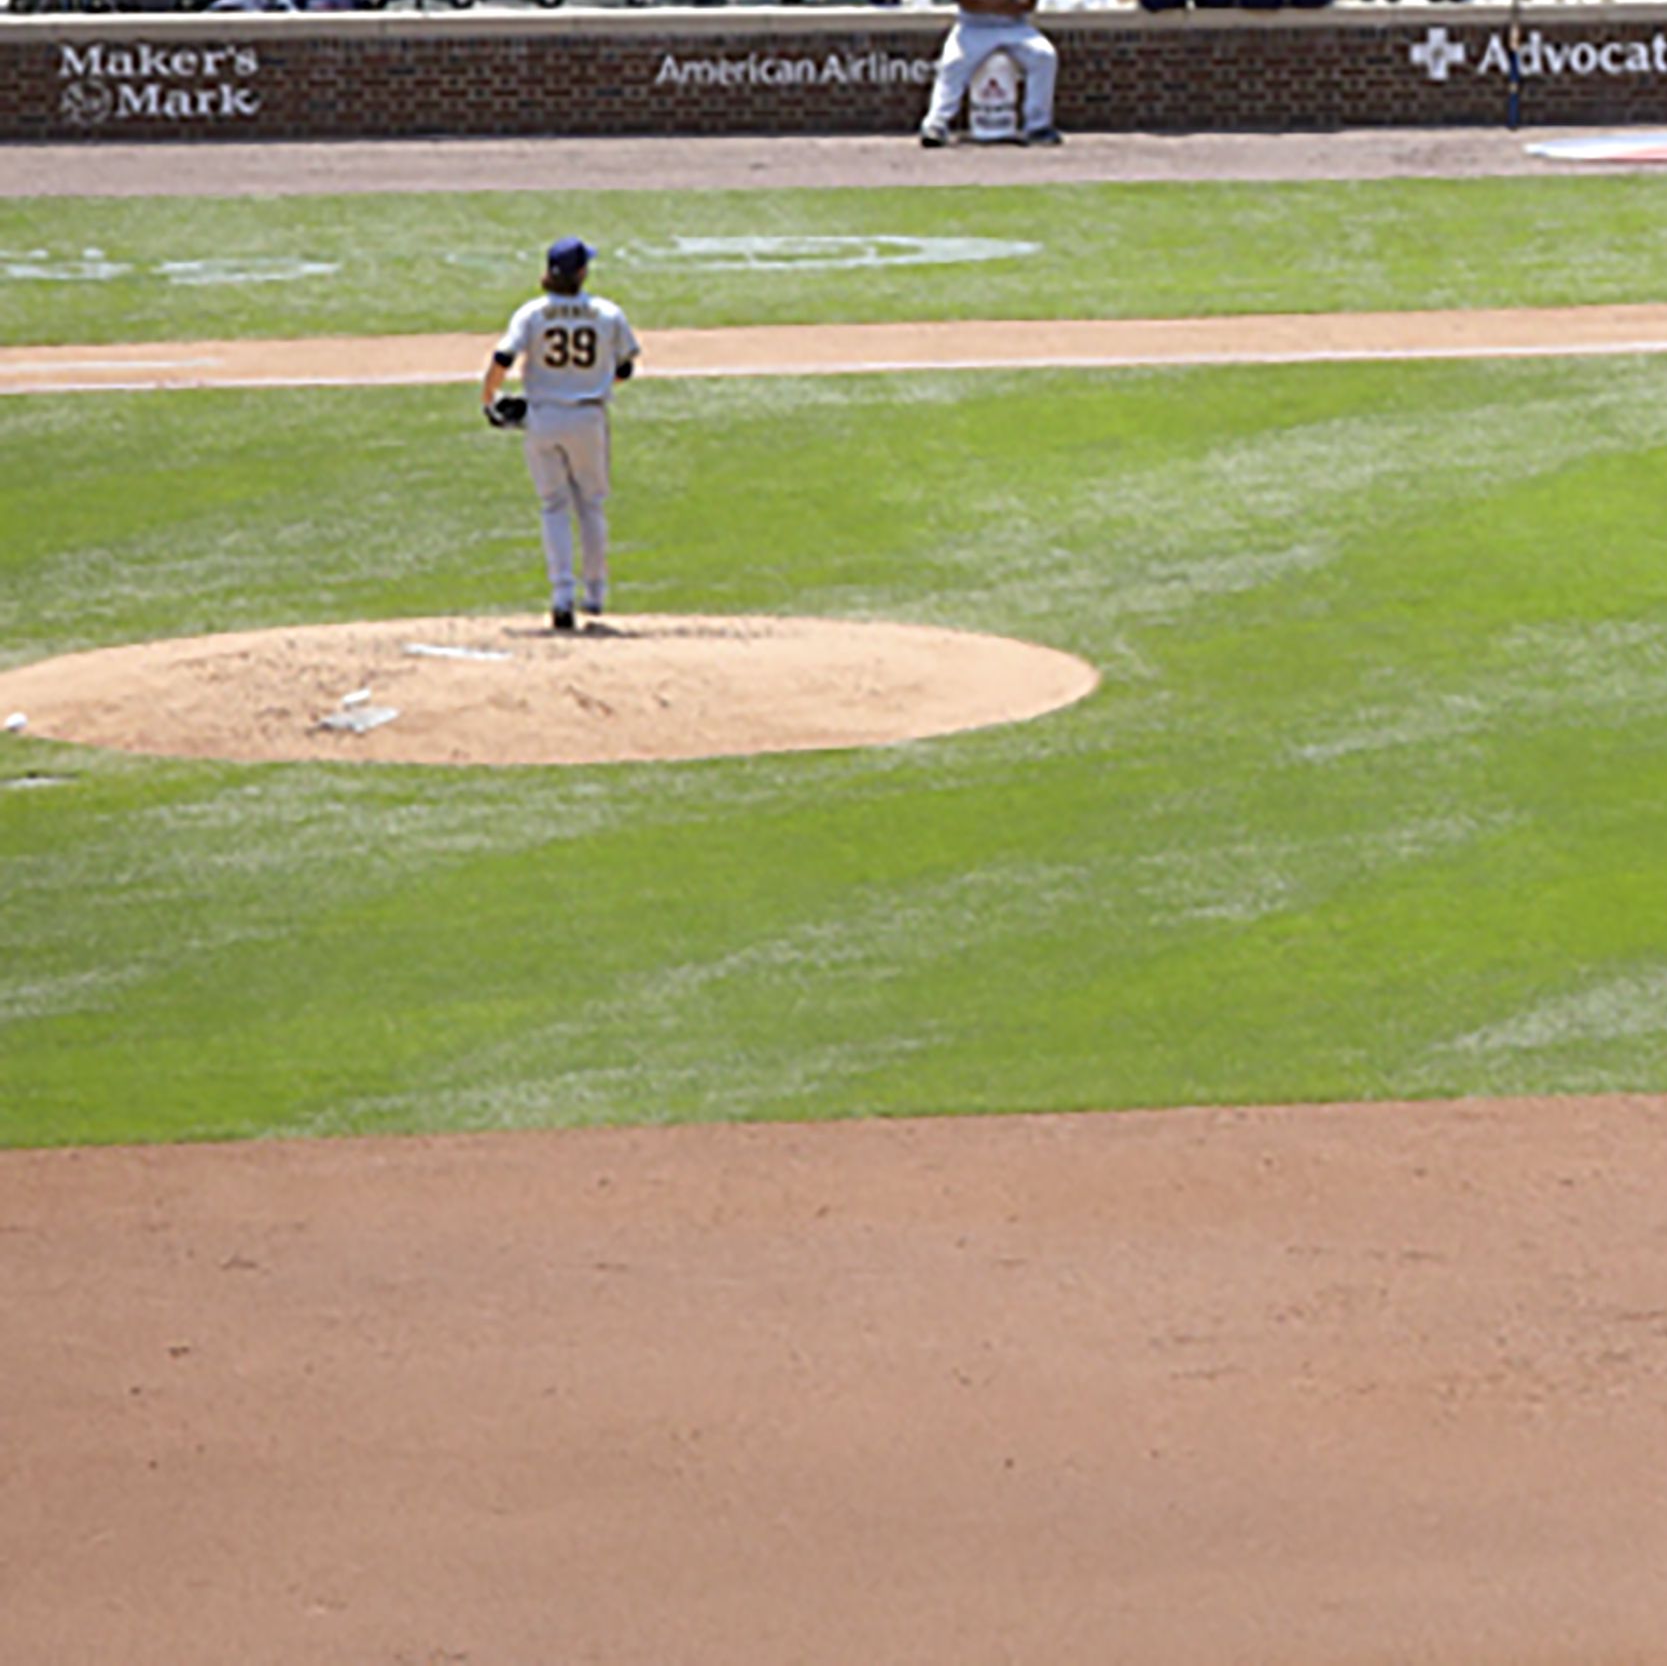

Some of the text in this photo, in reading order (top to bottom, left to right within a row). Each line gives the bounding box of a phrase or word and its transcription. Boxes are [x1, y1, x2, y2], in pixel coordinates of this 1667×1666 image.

[59, 43, 259, 77] Maker's
[655, 54, 816, 85] American
[115, 83, 263, 118] Mark
[543, 325, 598, 370] 39
